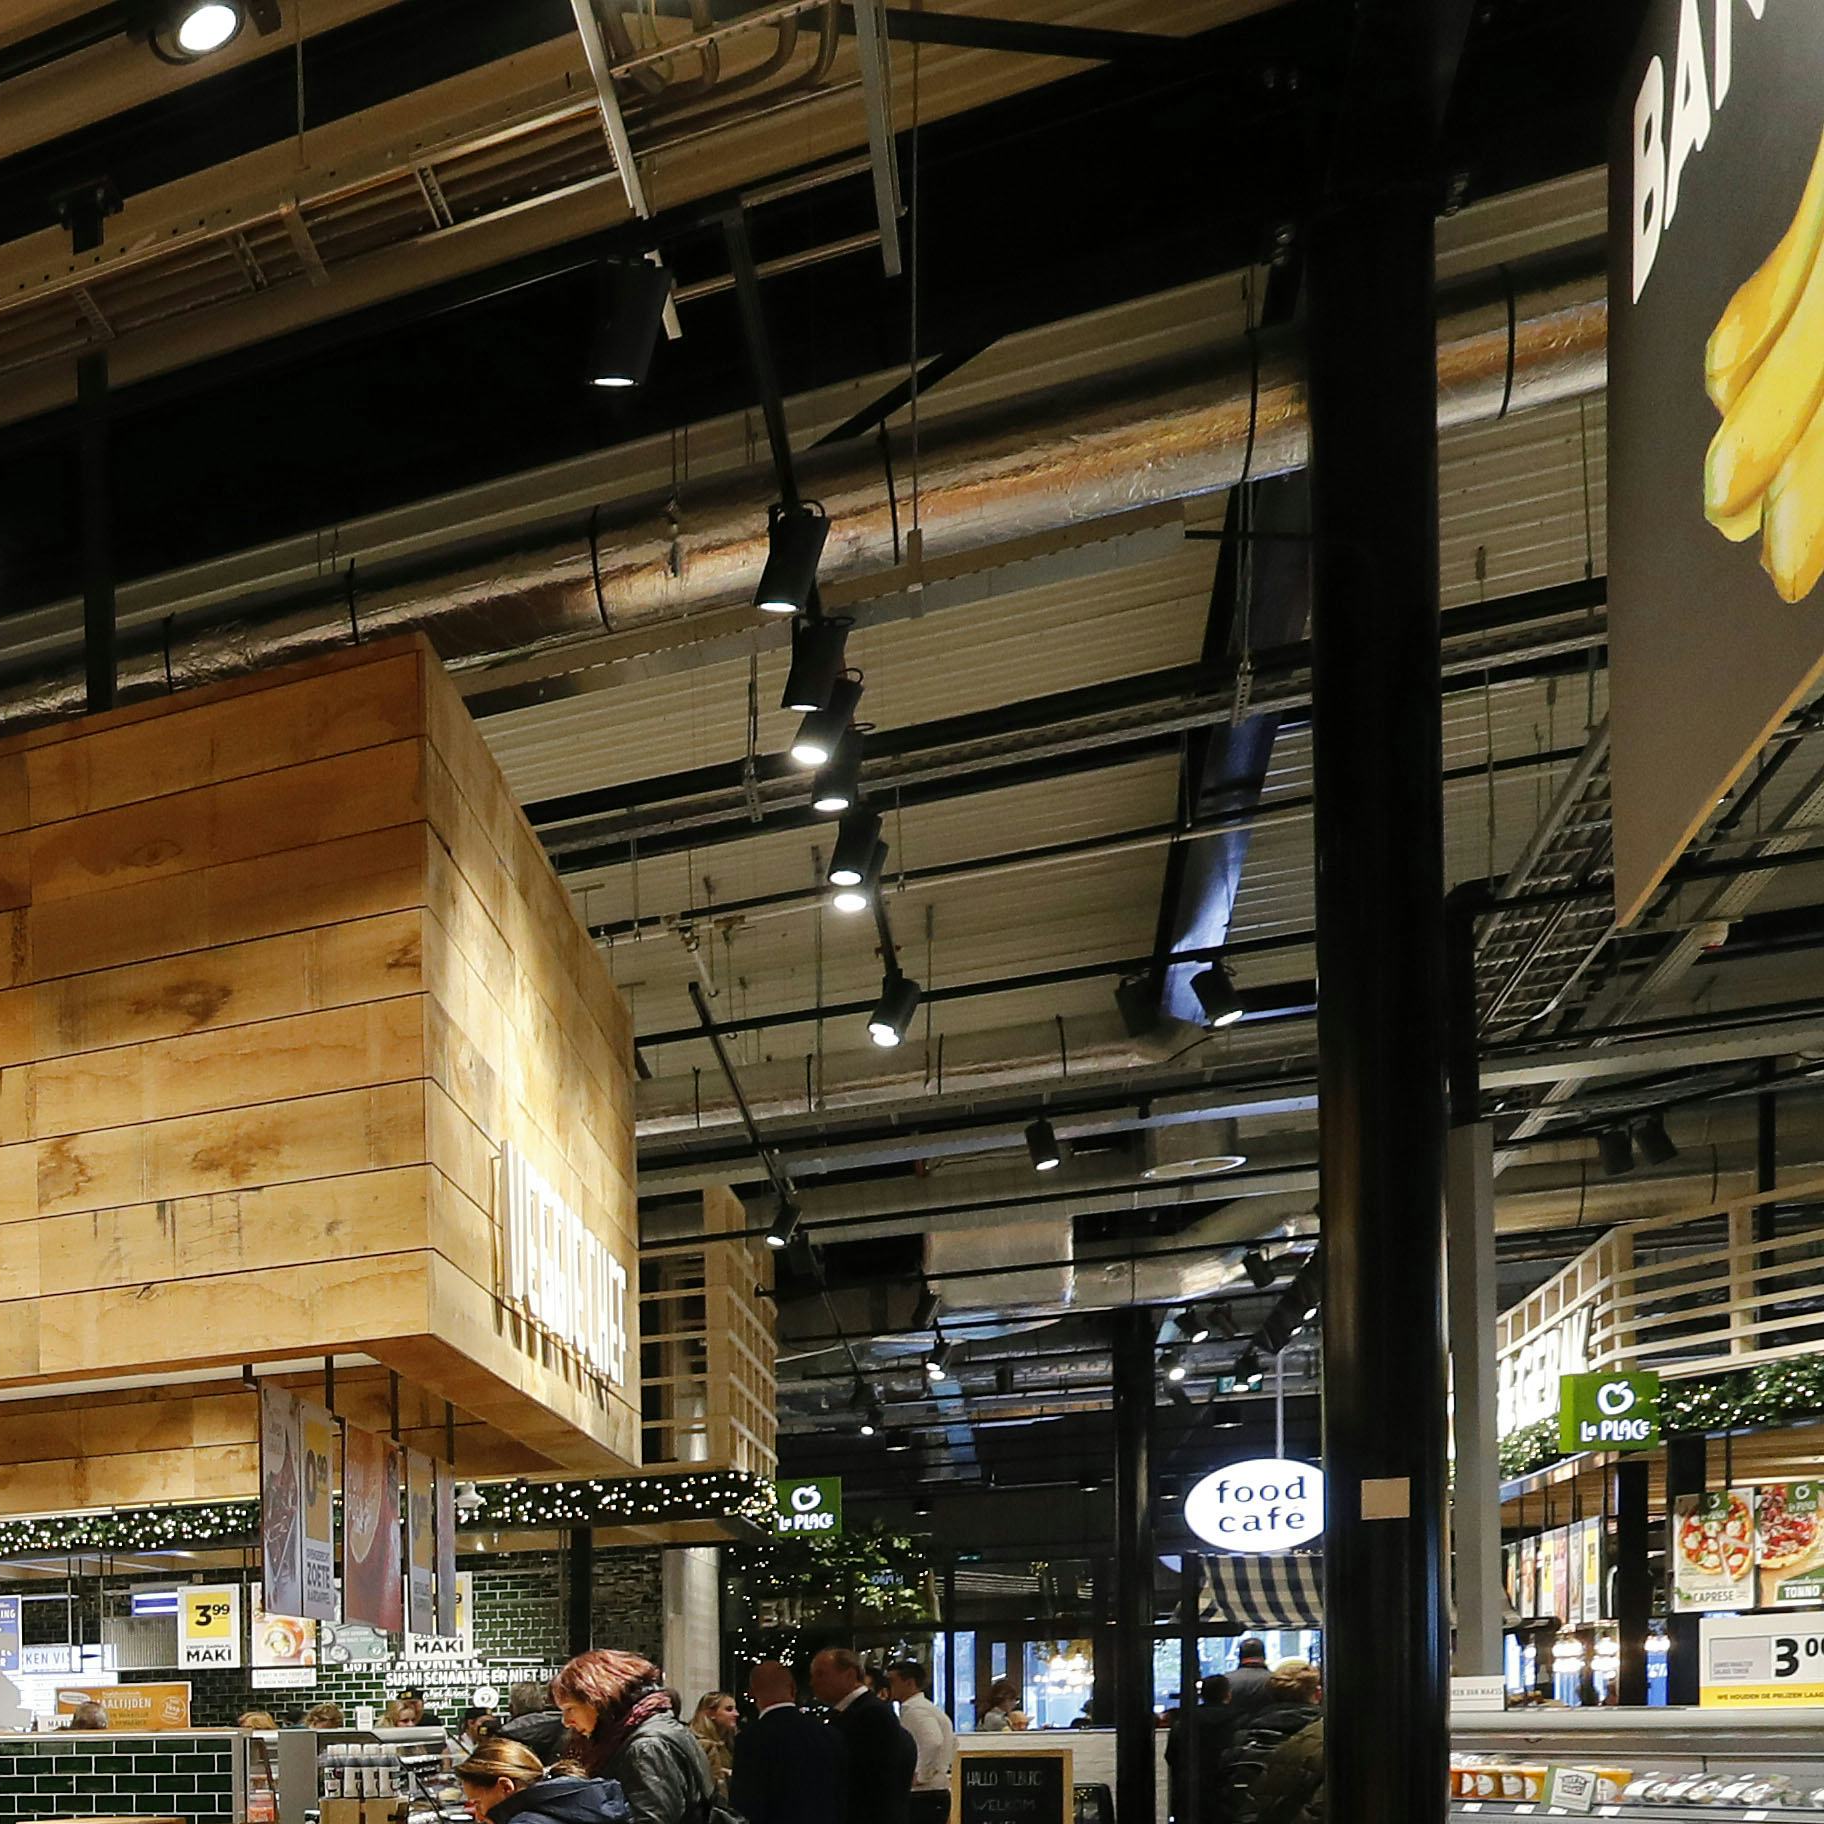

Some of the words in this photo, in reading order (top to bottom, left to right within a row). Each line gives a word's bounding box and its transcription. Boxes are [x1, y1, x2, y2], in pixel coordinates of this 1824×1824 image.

[1601, 1419, 1650, 1441] PLACE
[1216, 1475, 1307, 1503] food
[793, 1512, 834, 1530] PLACE
[1218, 1506, 1304, 1532] café
[1693, 1590, 1734, 1602] CAPRESE
[186, 1649, 232, 1662] MAKI
[414, 1639, 464, 1654] MAKI
[385, 1672, 422, 1687] SUSHI
[423, 1670, 491, 1686] SCHAALTJE
[491, 1669, 508, 1683] ER
[509, 1668, 538, 1682] NIET
